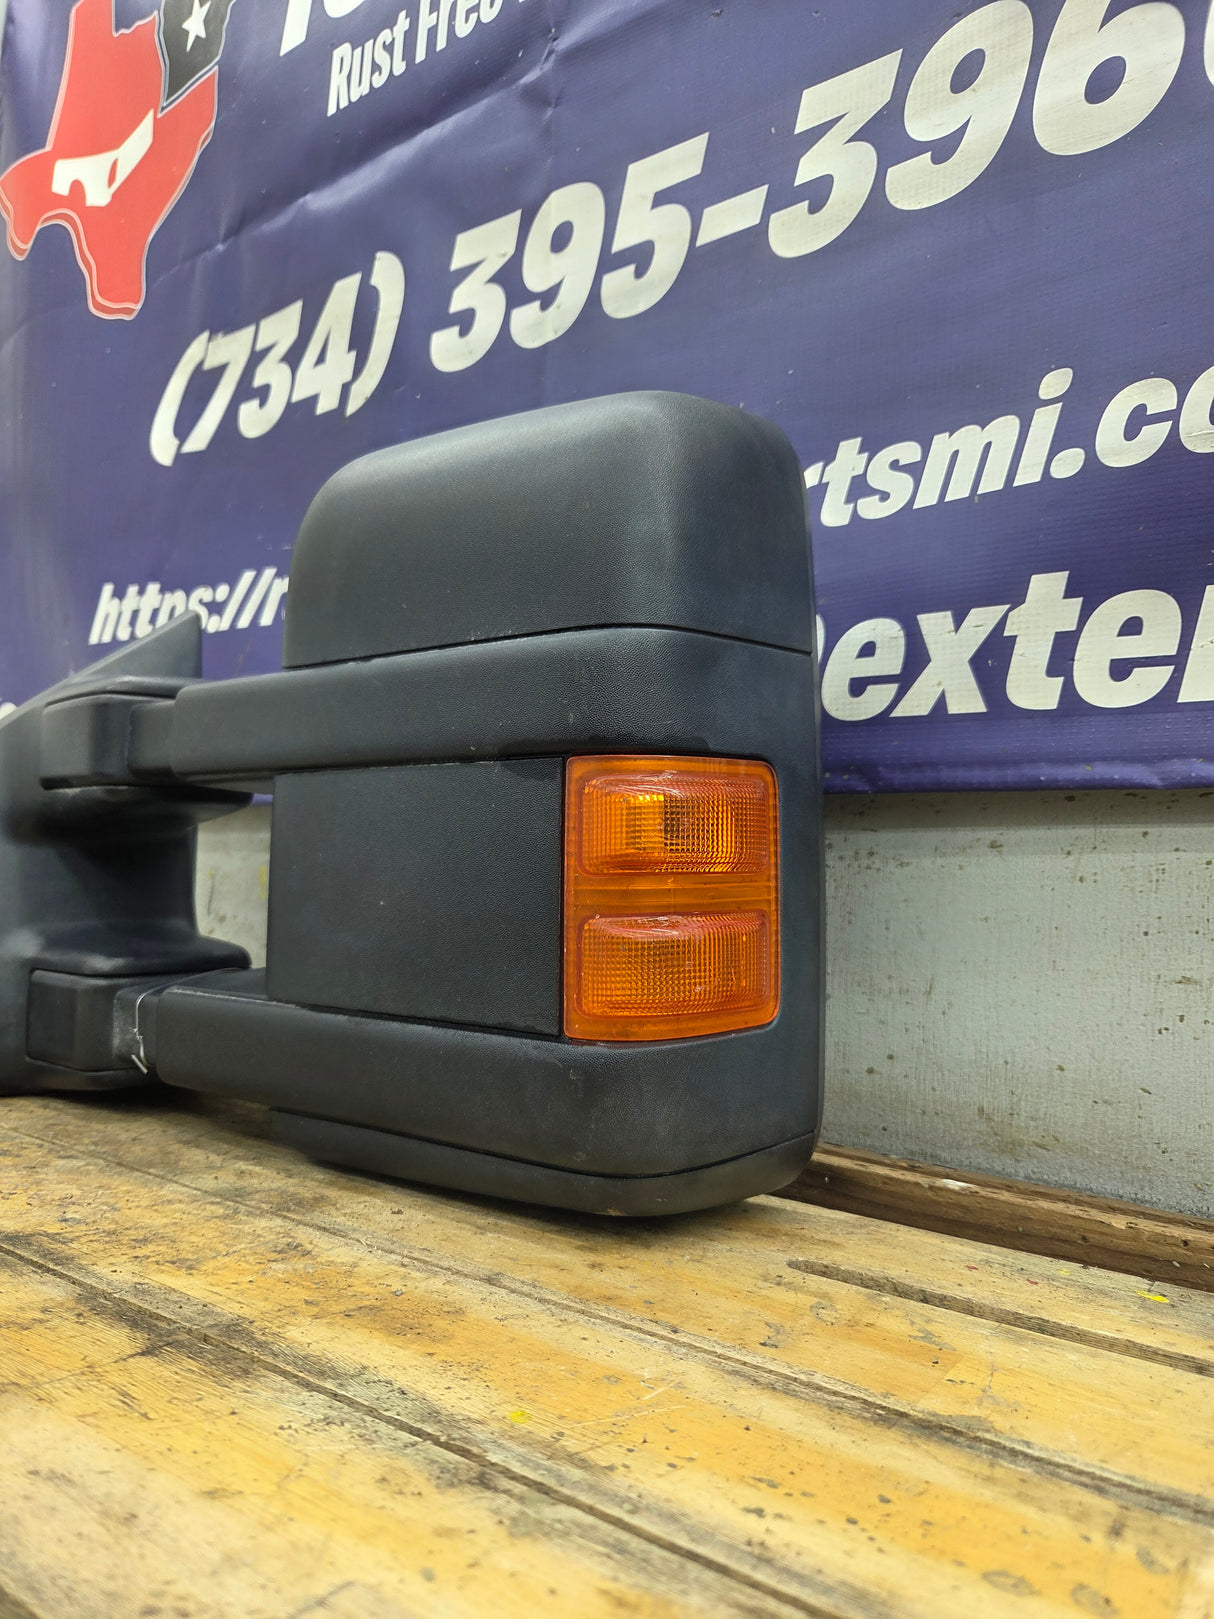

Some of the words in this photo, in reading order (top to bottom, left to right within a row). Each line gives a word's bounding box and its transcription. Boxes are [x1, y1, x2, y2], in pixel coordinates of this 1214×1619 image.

[327, 9, 410, 117] Rust
[149, 251, 406, 467] (734)
[430, 0, 1214, 373] 395-396
[816, 571, 1214, 721] exte
